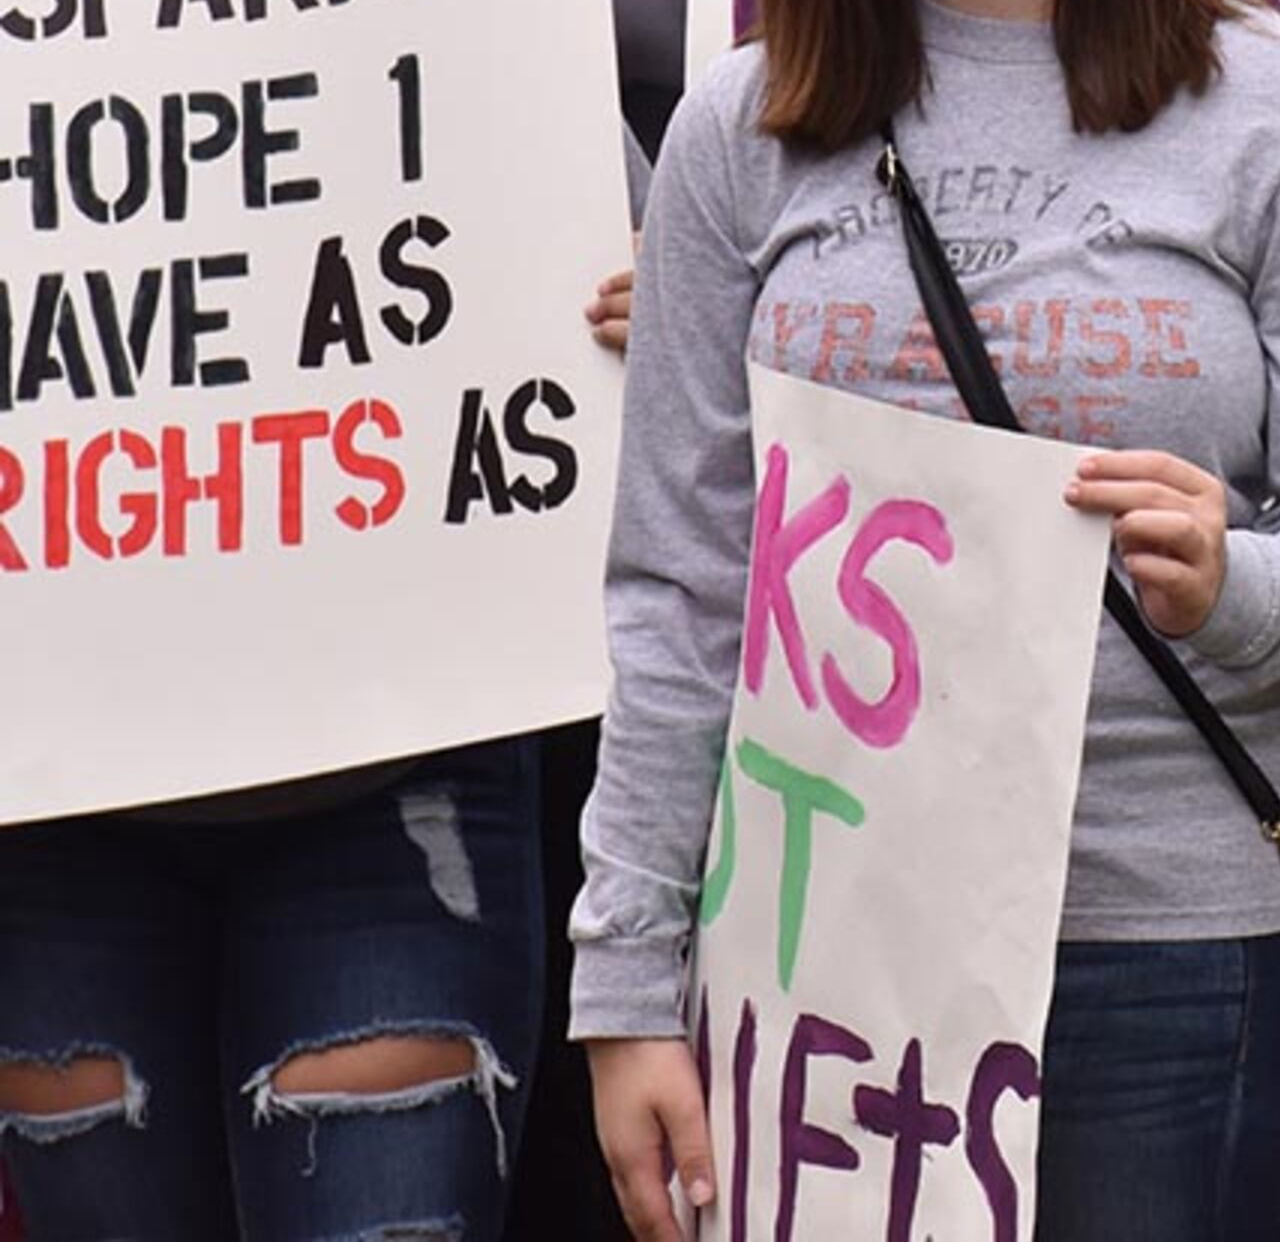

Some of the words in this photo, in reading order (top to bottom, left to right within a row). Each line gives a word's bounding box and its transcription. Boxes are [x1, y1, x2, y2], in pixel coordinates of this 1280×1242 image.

[0, 253, 250, 412] AVE
[298, 215, 453, 369] AS
[444, 378, 578, 525] AS
